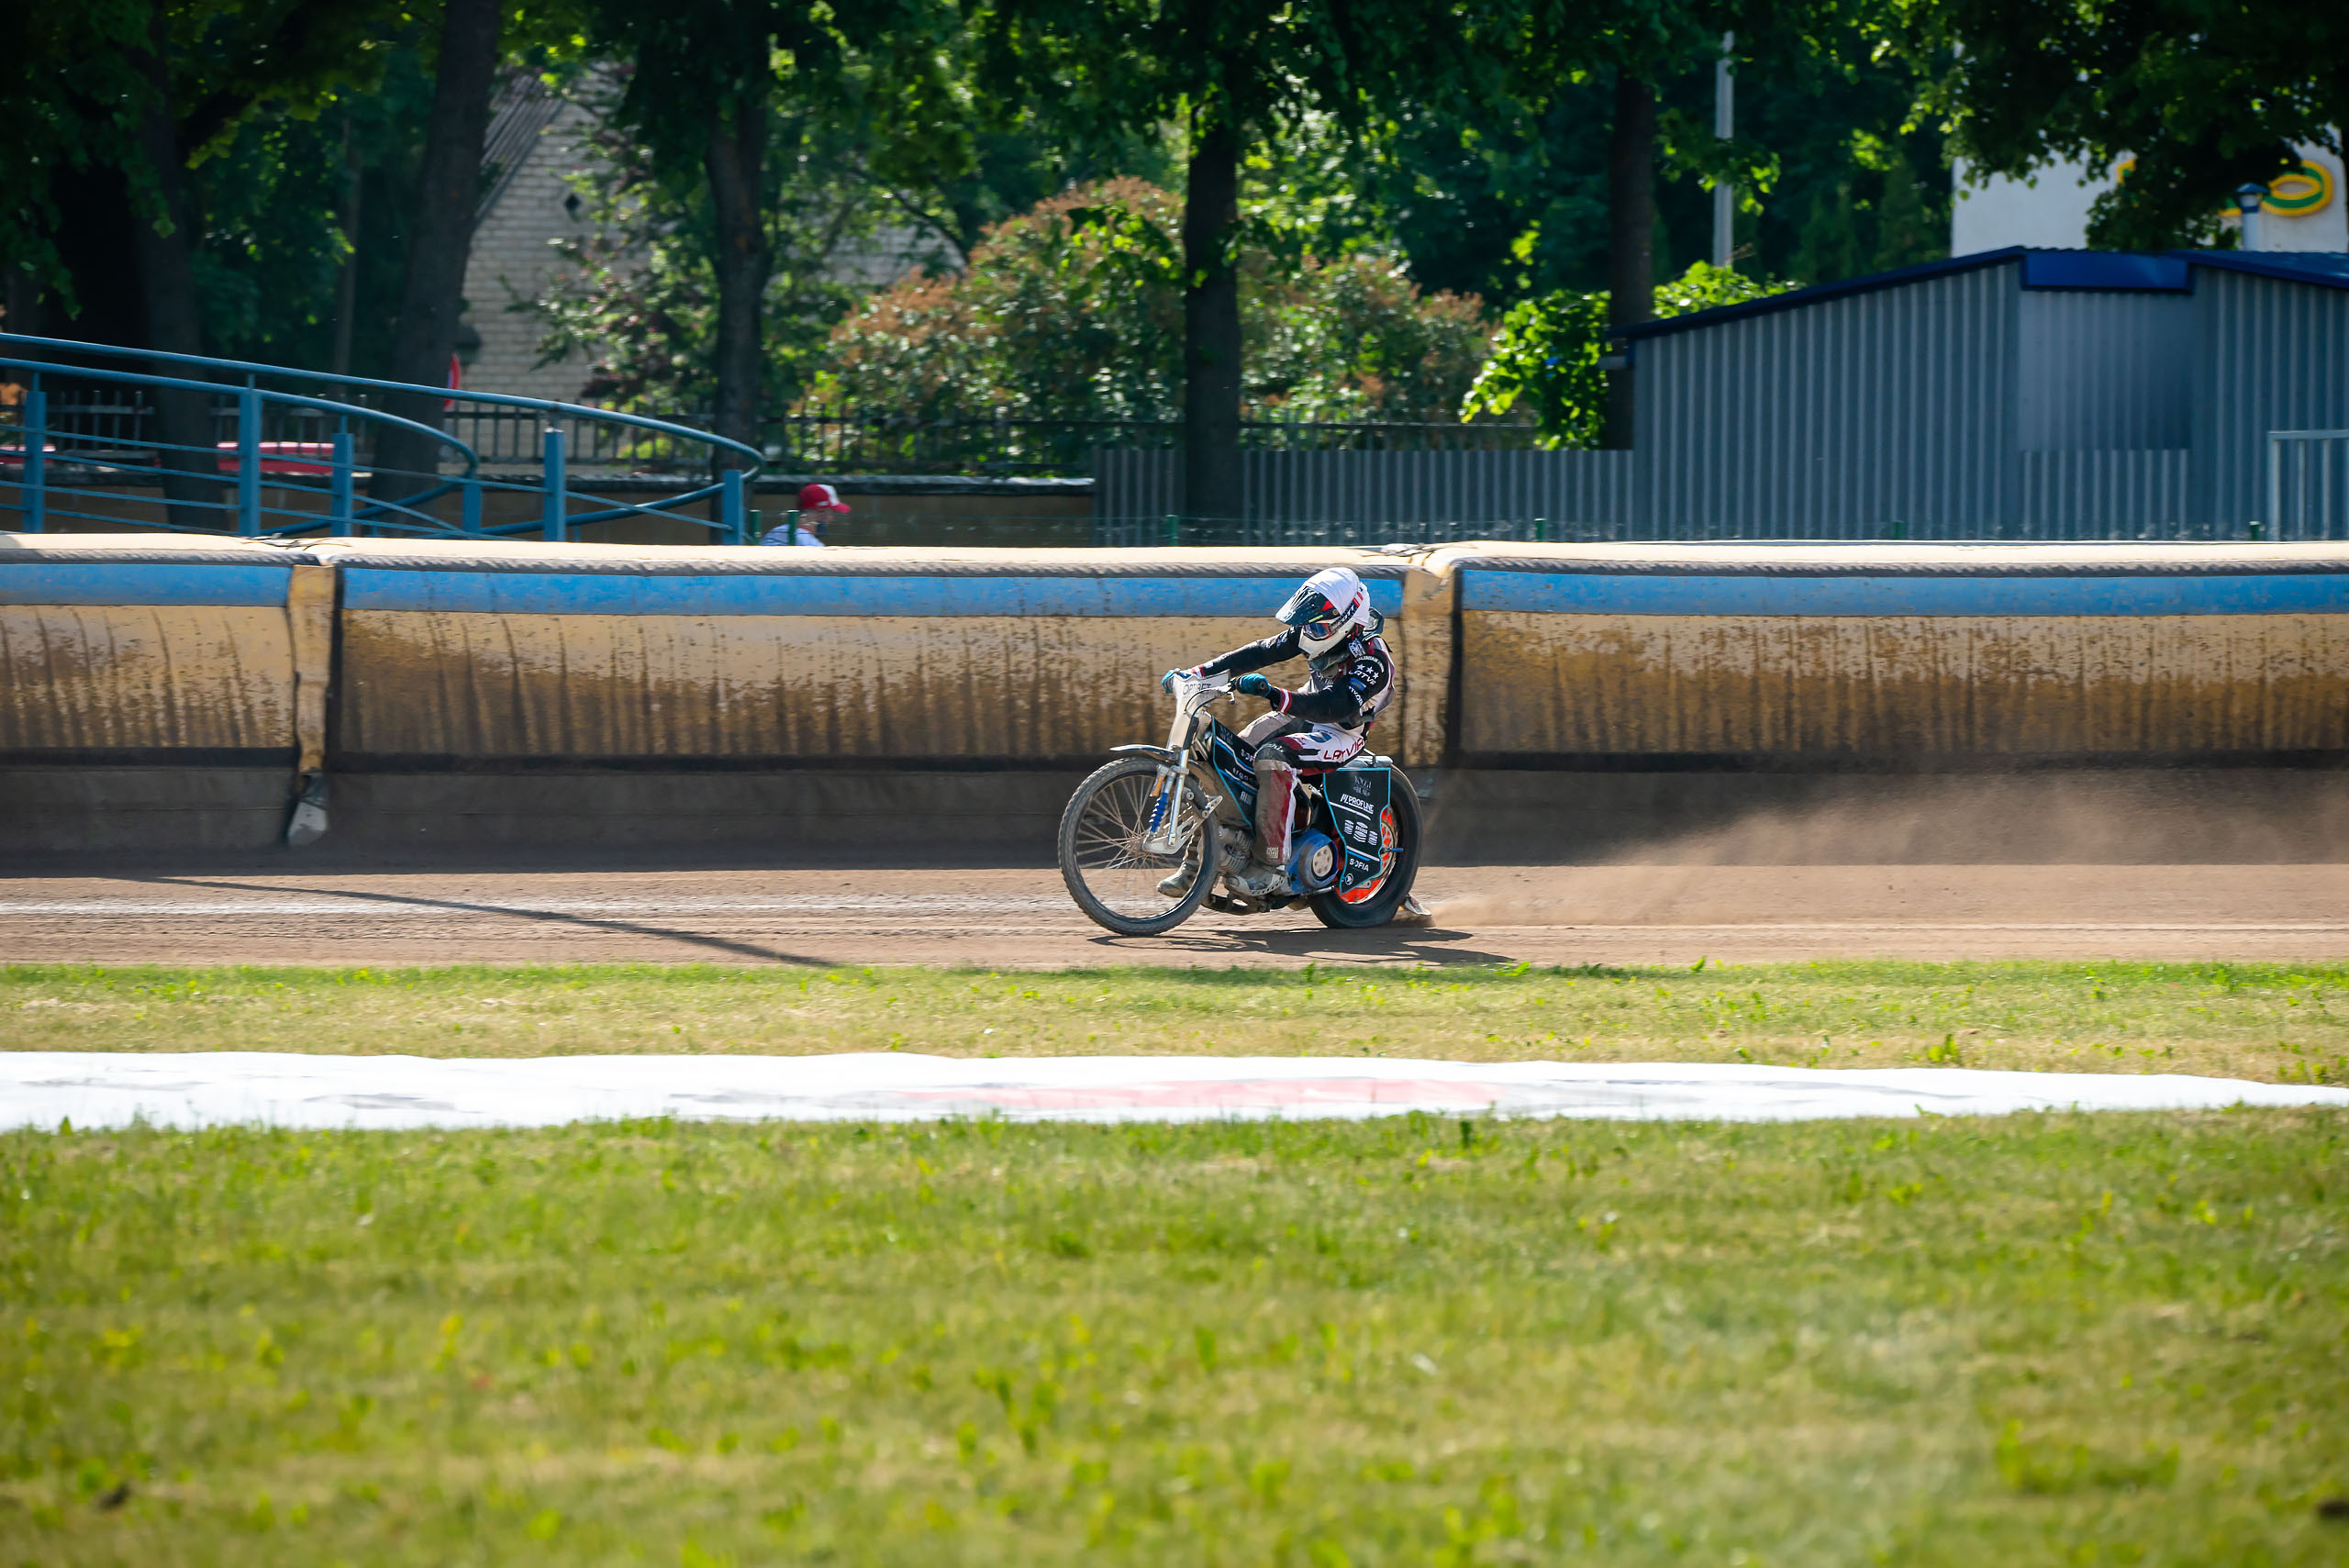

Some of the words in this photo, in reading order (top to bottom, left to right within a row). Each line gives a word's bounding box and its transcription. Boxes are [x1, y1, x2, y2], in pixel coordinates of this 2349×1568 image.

[1322, 737, 1364, 761] LATVIA
[1348, 795, 1375, 812] PROFLINE
[1349, 858, 1369, 872] SOFIA
